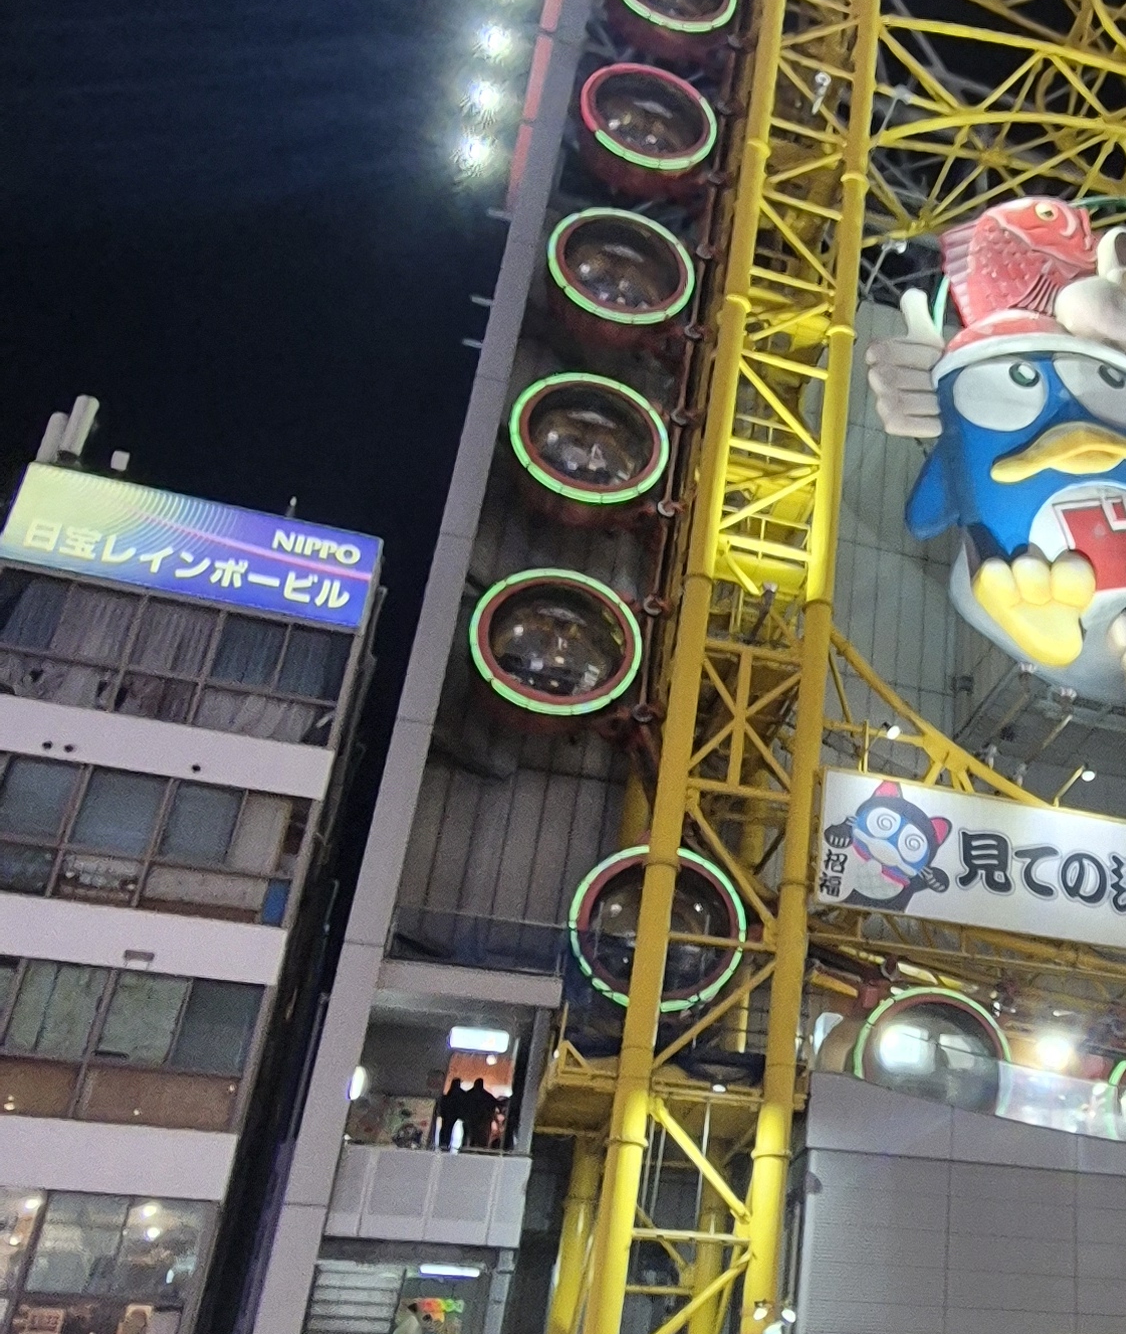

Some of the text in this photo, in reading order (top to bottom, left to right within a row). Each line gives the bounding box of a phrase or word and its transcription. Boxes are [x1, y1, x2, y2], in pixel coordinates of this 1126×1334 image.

[25, 521, 351, 609] 日宝レインボービル
[272, 528, 362, 566] NIPPO
[819, 848, 848, 898] 招福
